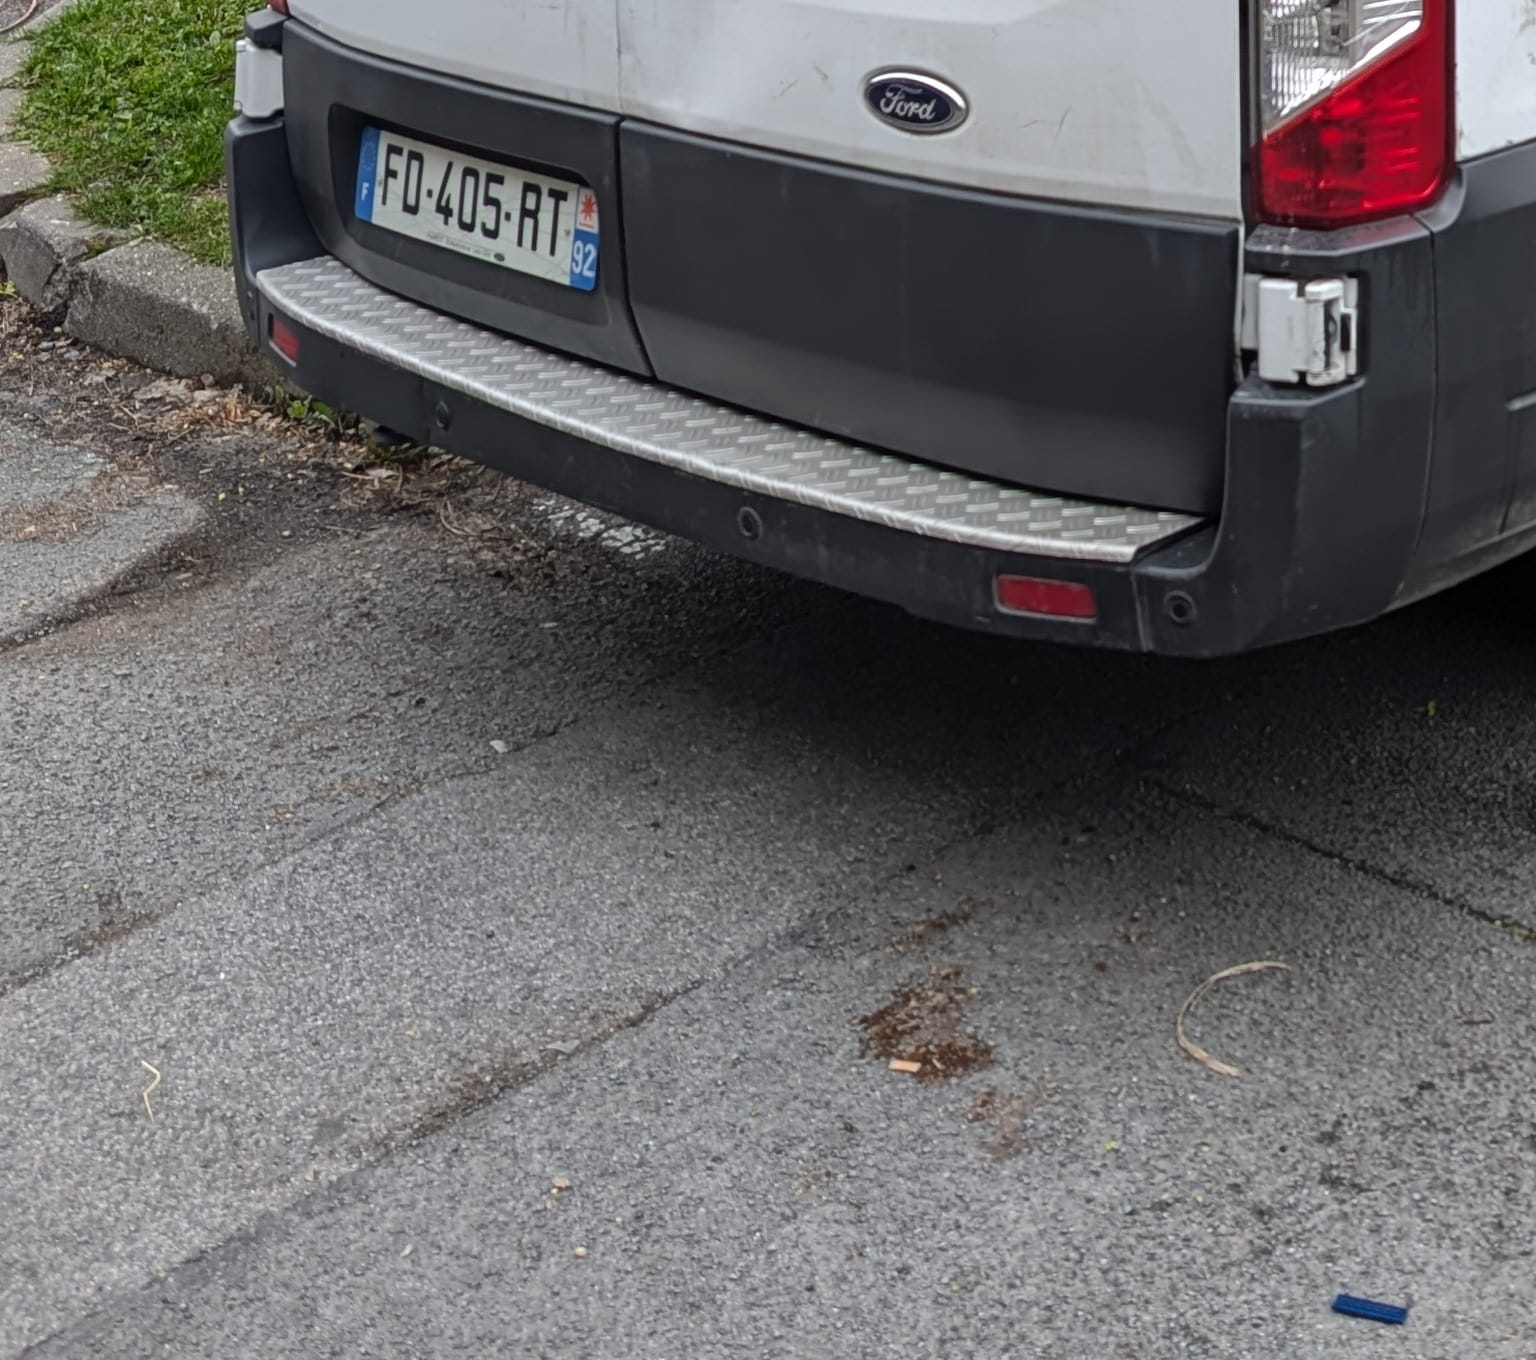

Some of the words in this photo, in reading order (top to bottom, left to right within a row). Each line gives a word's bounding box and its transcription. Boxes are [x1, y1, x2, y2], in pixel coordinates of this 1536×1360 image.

[880, 83, 936, 120] Ford
[360, 182, 369, 201] F
[572, 240, 597, 277] 92
